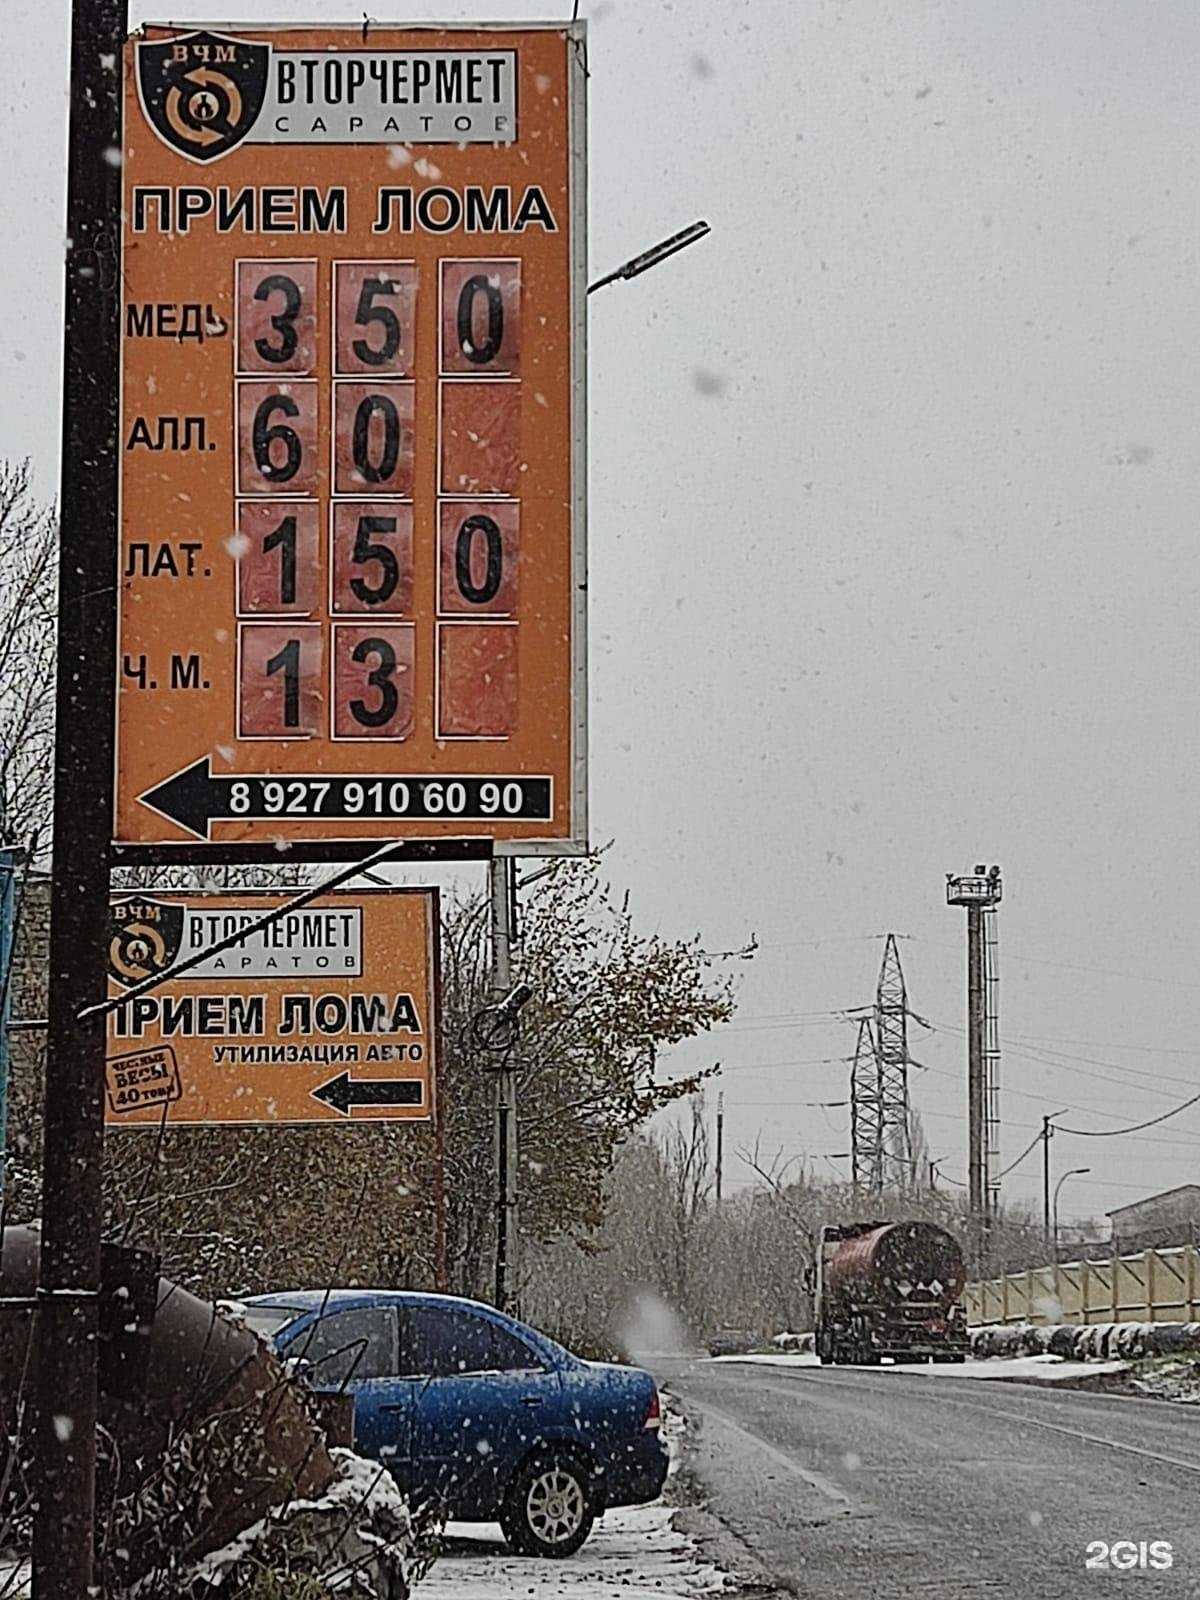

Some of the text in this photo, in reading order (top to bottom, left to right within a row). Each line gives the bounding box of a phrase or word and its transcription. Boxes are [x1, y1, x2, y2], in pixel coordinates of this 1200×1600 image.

[173, 45, 237, 63] ВЧМ
[277, 59, 506, 104] ВТОРЧЕРМЕТ
[133, 186, 557, 233] ПРИЕМ ЛОМА
[127, 304, 228, 344] МЕДЬ
[127, 418, 217, 450] АЛЛ.
[125, 544, 212, 577] ЛАТ.
[229, 784, 523, 813] 8 927 910 60 90
[114, 905, 161, 921] ВЧМ
[191, 956, 355, 969] АРАТОВ
[279, 994, 422, 1034] ЛОМА
[214, 1045, 358, 1065] УТИЛИЗАЦИЯ
